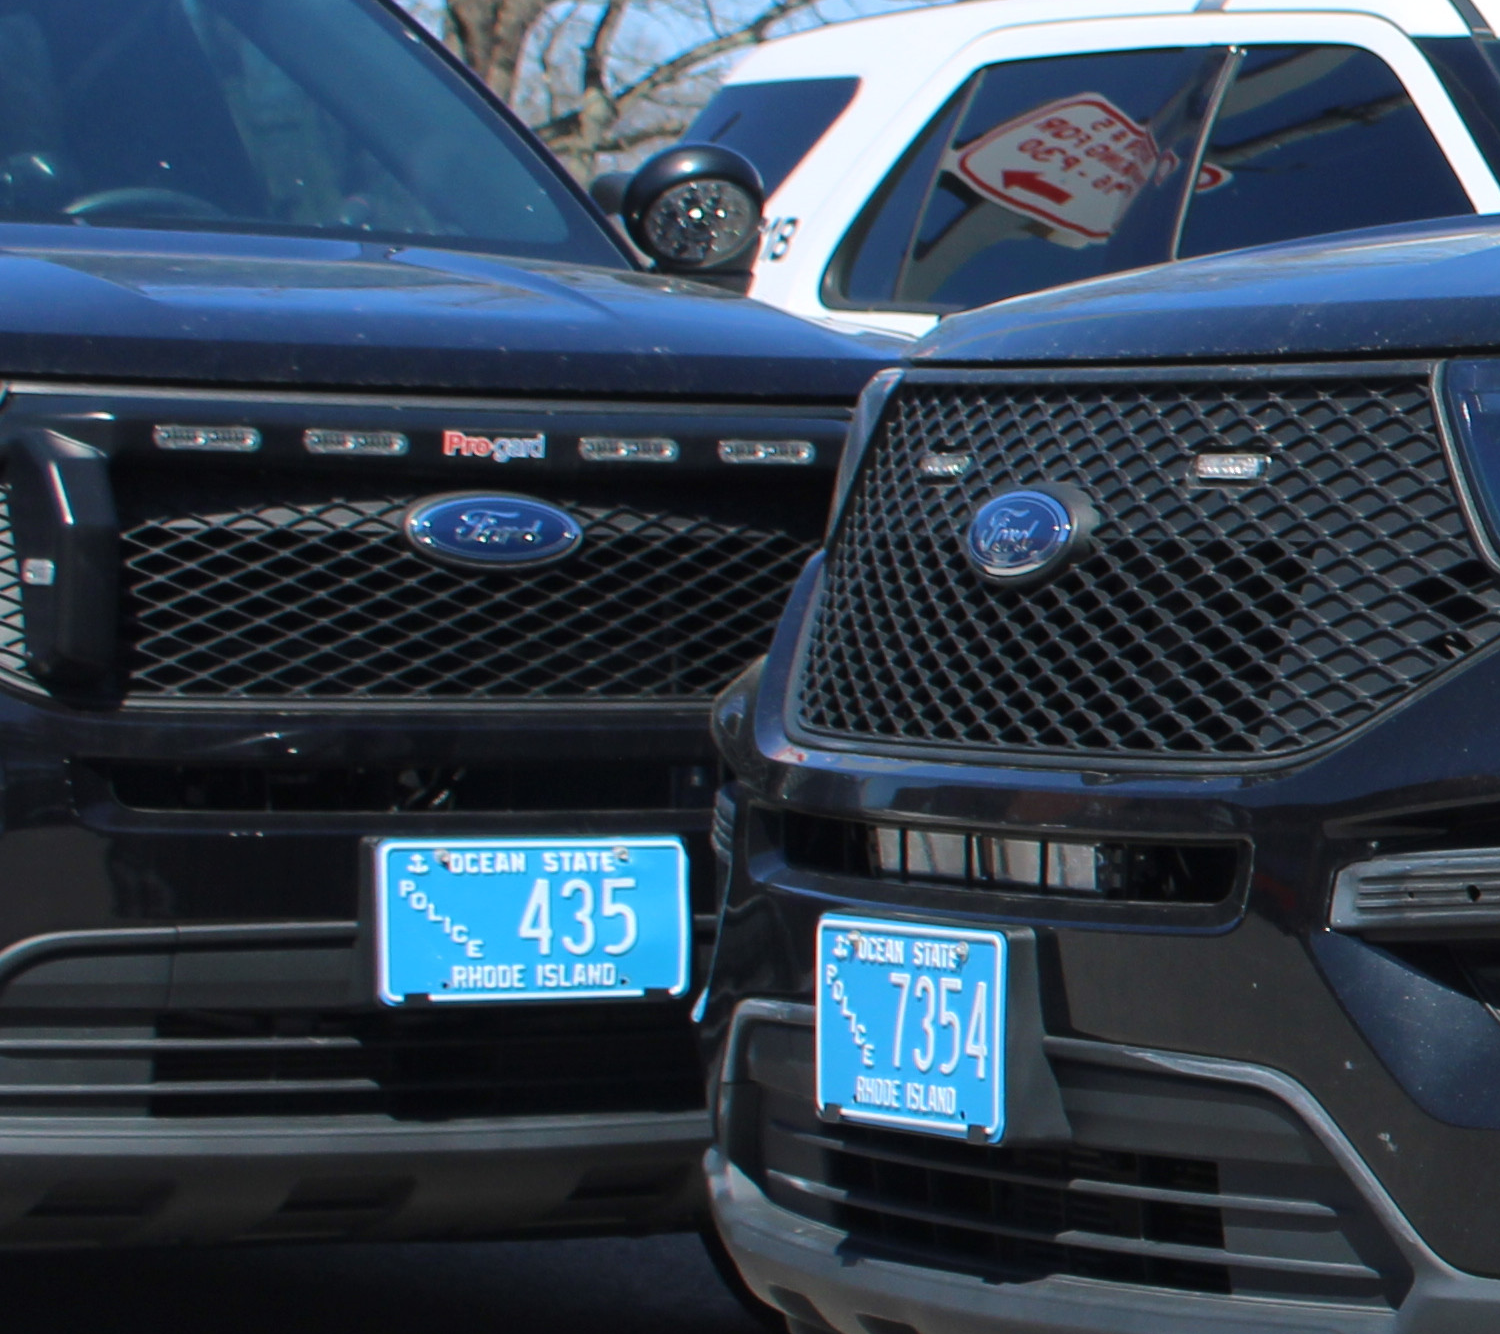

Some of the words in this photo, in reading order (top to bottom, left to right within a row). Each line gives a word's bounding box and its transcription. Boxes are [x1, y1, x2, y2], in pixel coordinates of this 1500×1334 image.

[451, 851, 526, 874] OCEAN
[543, 851, 617, 873] STATE
[400, 879, 484, 958] POLICE
[518, 877, 638, 956] 435
[451, 965, 525, 989] RHODE
[537, 963, 617, 987] ISLAND
[857, 936, 905, 965] OCEAN
[912, 941, 961, 969] STATE
[826, 963, 876, 1068] POLICE
[889, 972, 988, 1080] 7354
[856, 1075, 901, 1108] RHODE
[906, 1081, 957, 1115] ISLAND
